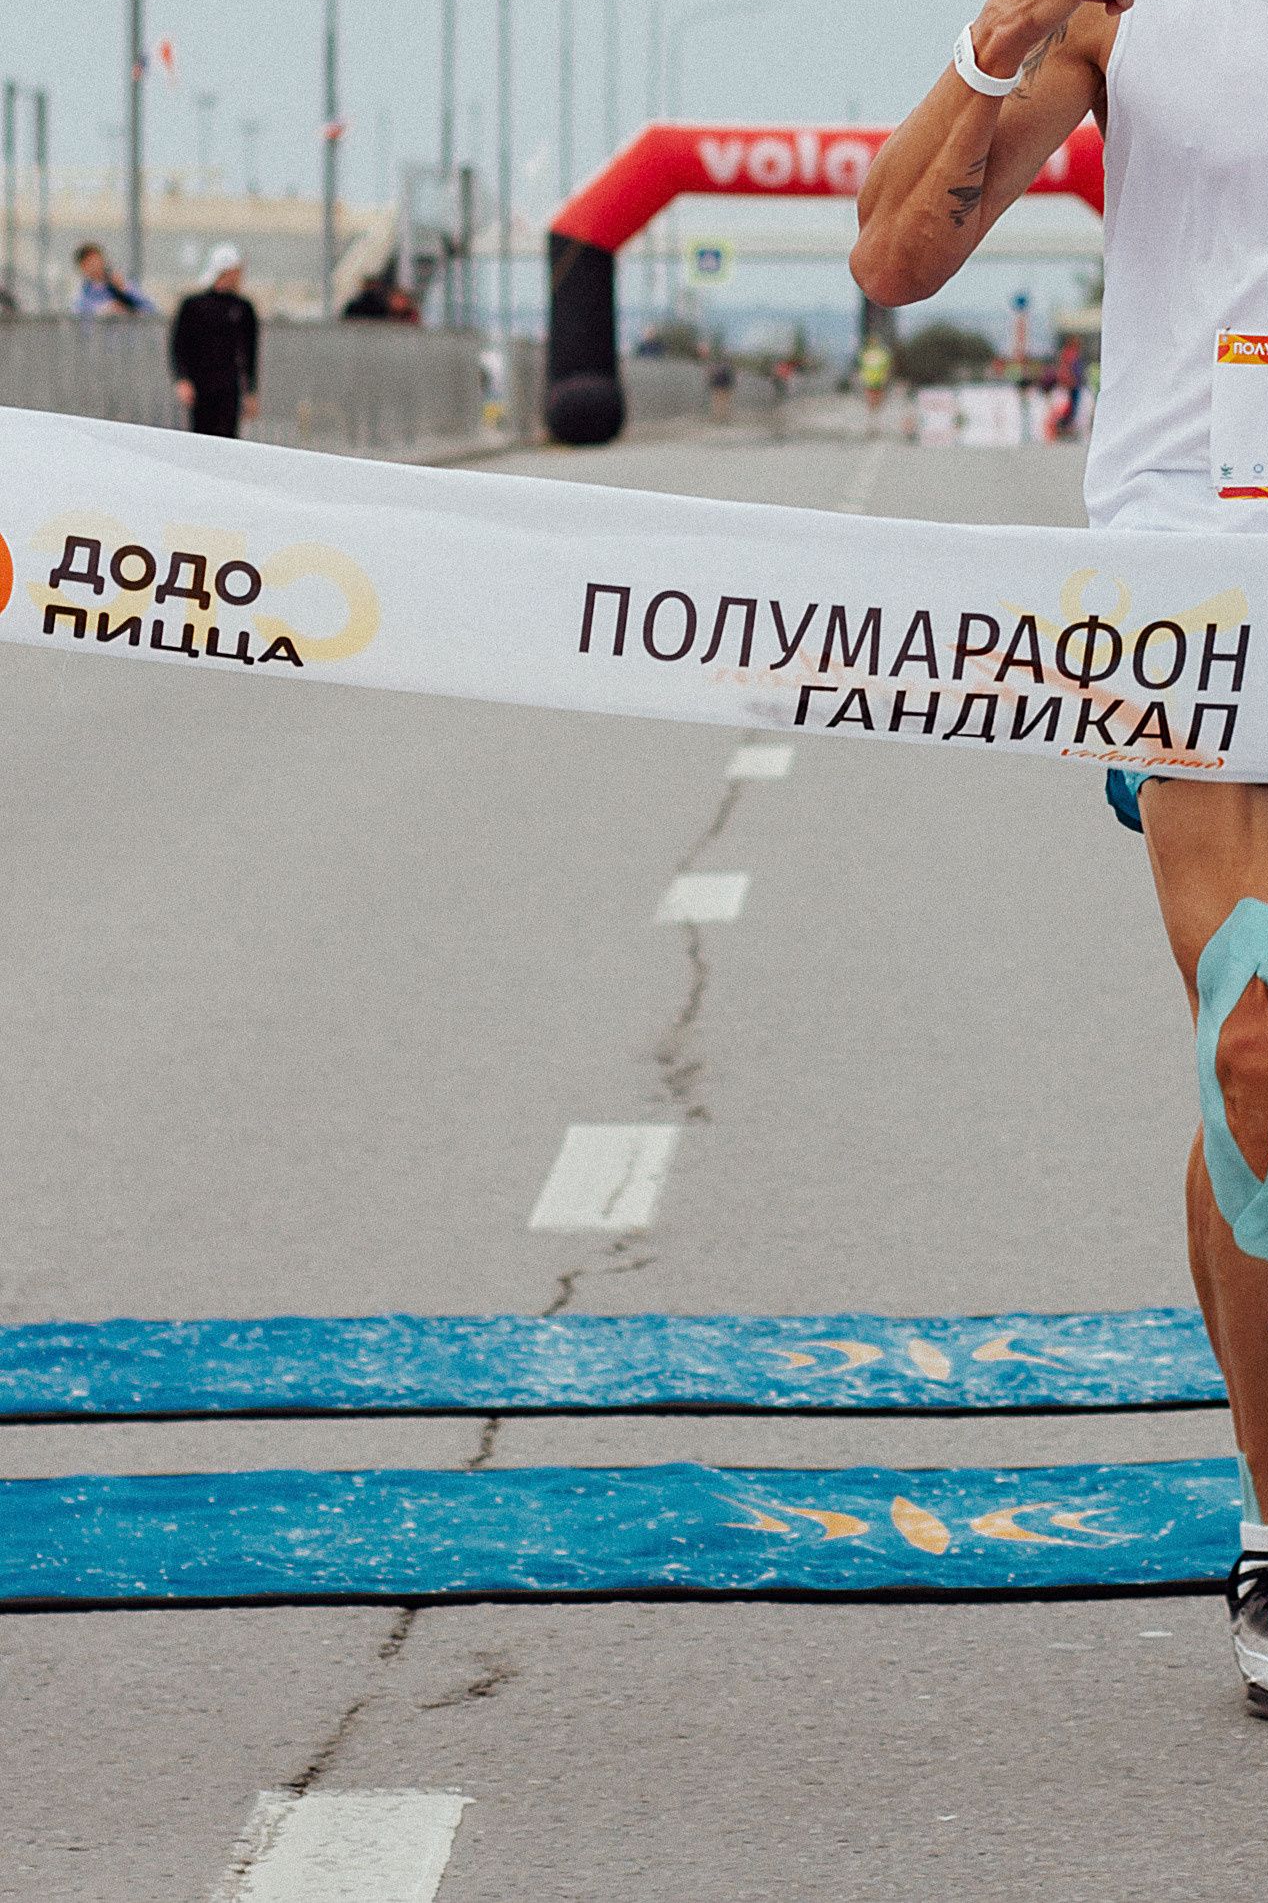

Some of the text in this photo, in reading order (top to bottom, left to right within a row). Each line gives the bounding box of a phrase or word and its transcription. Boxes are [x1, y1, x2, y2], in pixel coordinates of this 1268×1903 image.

[49, 535, 262, 610] ДОДО
[42, 604, 304, 667] ПИЦЦА
[579, 582, 1251, 692] ПОЛУМАРАФОН
[793, 685, 1239, 752] ГАНДИКАП
